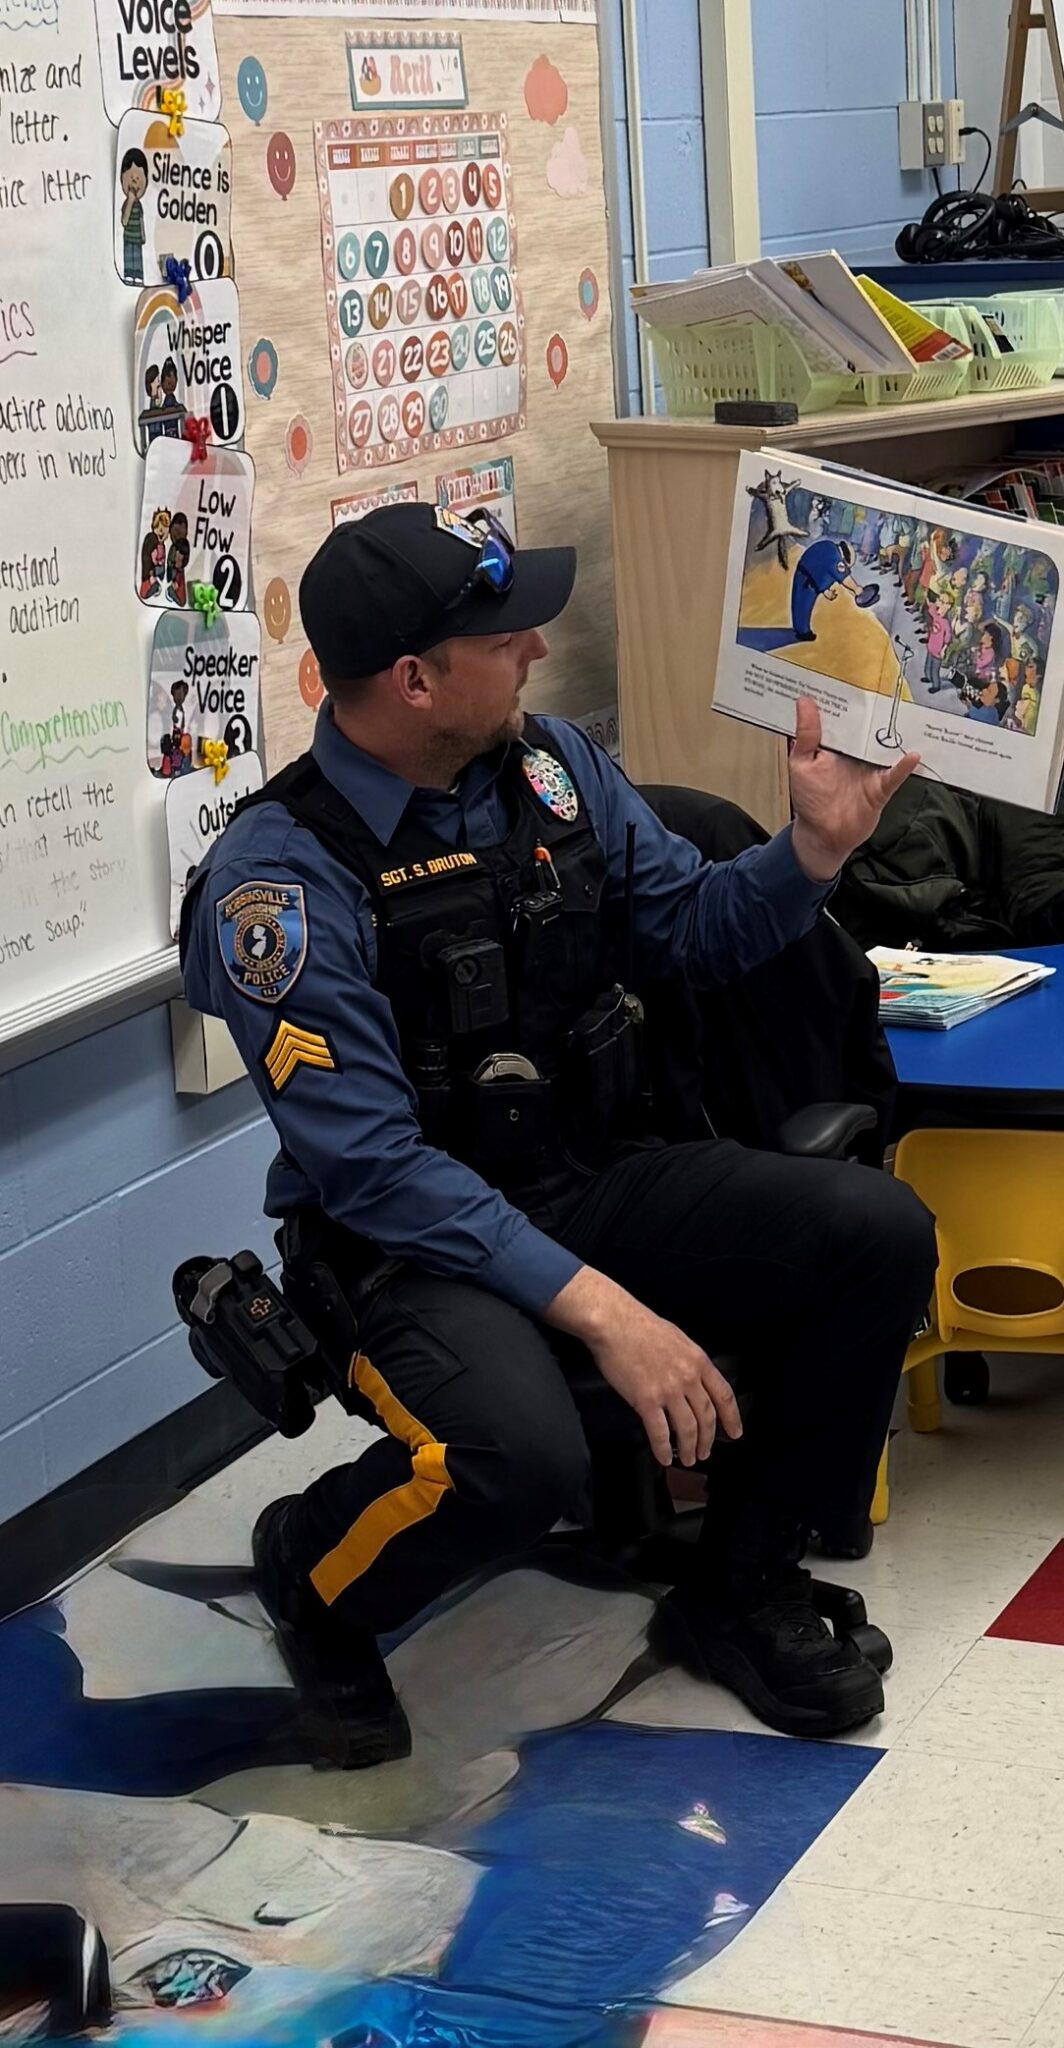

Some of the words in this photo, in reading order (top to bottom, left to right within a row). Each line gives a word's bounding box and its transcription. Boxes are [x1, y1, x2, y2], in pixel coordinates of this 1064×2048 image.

[117, 0, 193, 34] Voice
[45, 53, 82, 89] and
[116, 32, 200, 80] Levels
[41, 169, 92, 204] letter
[151, 151, 212, 191] Silence
[217, 161, 230, 194] is
[399, 181, 407, 211] 1
[427, 176, 438, 205] 2
[447, 179, 456, 204] 3
[468, 171, 478, 197] 4
[487, 171, 497, 198] 5
[157, 187, 217, 226] Golden
[200, 233, 220, 280] 0
[344, 242, 356, 269] 6
[371, 239, 383, 268] 7
[401, 237, 411, 265] 8
[428, 231, 440, 260] 9
[448, 228, 465, 257] 10
[471, 226, 482, 252] 11
[490, 225, 506, 252] 12
[344, 298, 361, 328] 13
[373, 290, 390, 321] 14
[401, 286, 420, 317] 15
[429, 282, 449, 313] 16
[451, 279, 465, 310] 17
[475, 276, 491, 304] 18
[494, 273, 511, 302] 19
[166, 319, 232, 355] Whisper
[377, 347, 395, 378] 21
[403, 343, 423, 375] 22
[429, 338, 450, 369] 23
[453, 331, 469, 361] 24
[477, 327, 497, 355] 25
[500, 329, 516, 356] 26
[181, 349, 232, 388] Voice
[55, 393, 117, 460] adding
[219, 385, 230, 438] 1
[353, 409, 371, 438] 27
[381, 403, 399, 433] 28
[406, 397, 424, 428] 29
[432, 394, 447, 423] 30
[37, 449, 59, 481] in
[68, 448, 106, 478] word
[197, 478, 237, 518] Low
[193, 515, 235, 553] Flow
[219, 558, 235, 608] 2
[9, 594, 80, 635] addition
[183, 645, 259, 687] Speaker
[196, 680, 246, 714] Voice
[0, 699, 129, 769] Comprehension
[230, 719, 246, 755] 3
[27, 785, 73, 819] retell
[82, 781, 116, 809] the
[199, 786, 250, 836] Outs
[63, 820, 104, 848] take
[51, 869, 81, 898] the
[380, 867, 413, 887] SGT.
[412, 863, 429, 877] S.
[427, 852, 478, 874] BRUTON
[242, 963, 291, 985] POLICE
